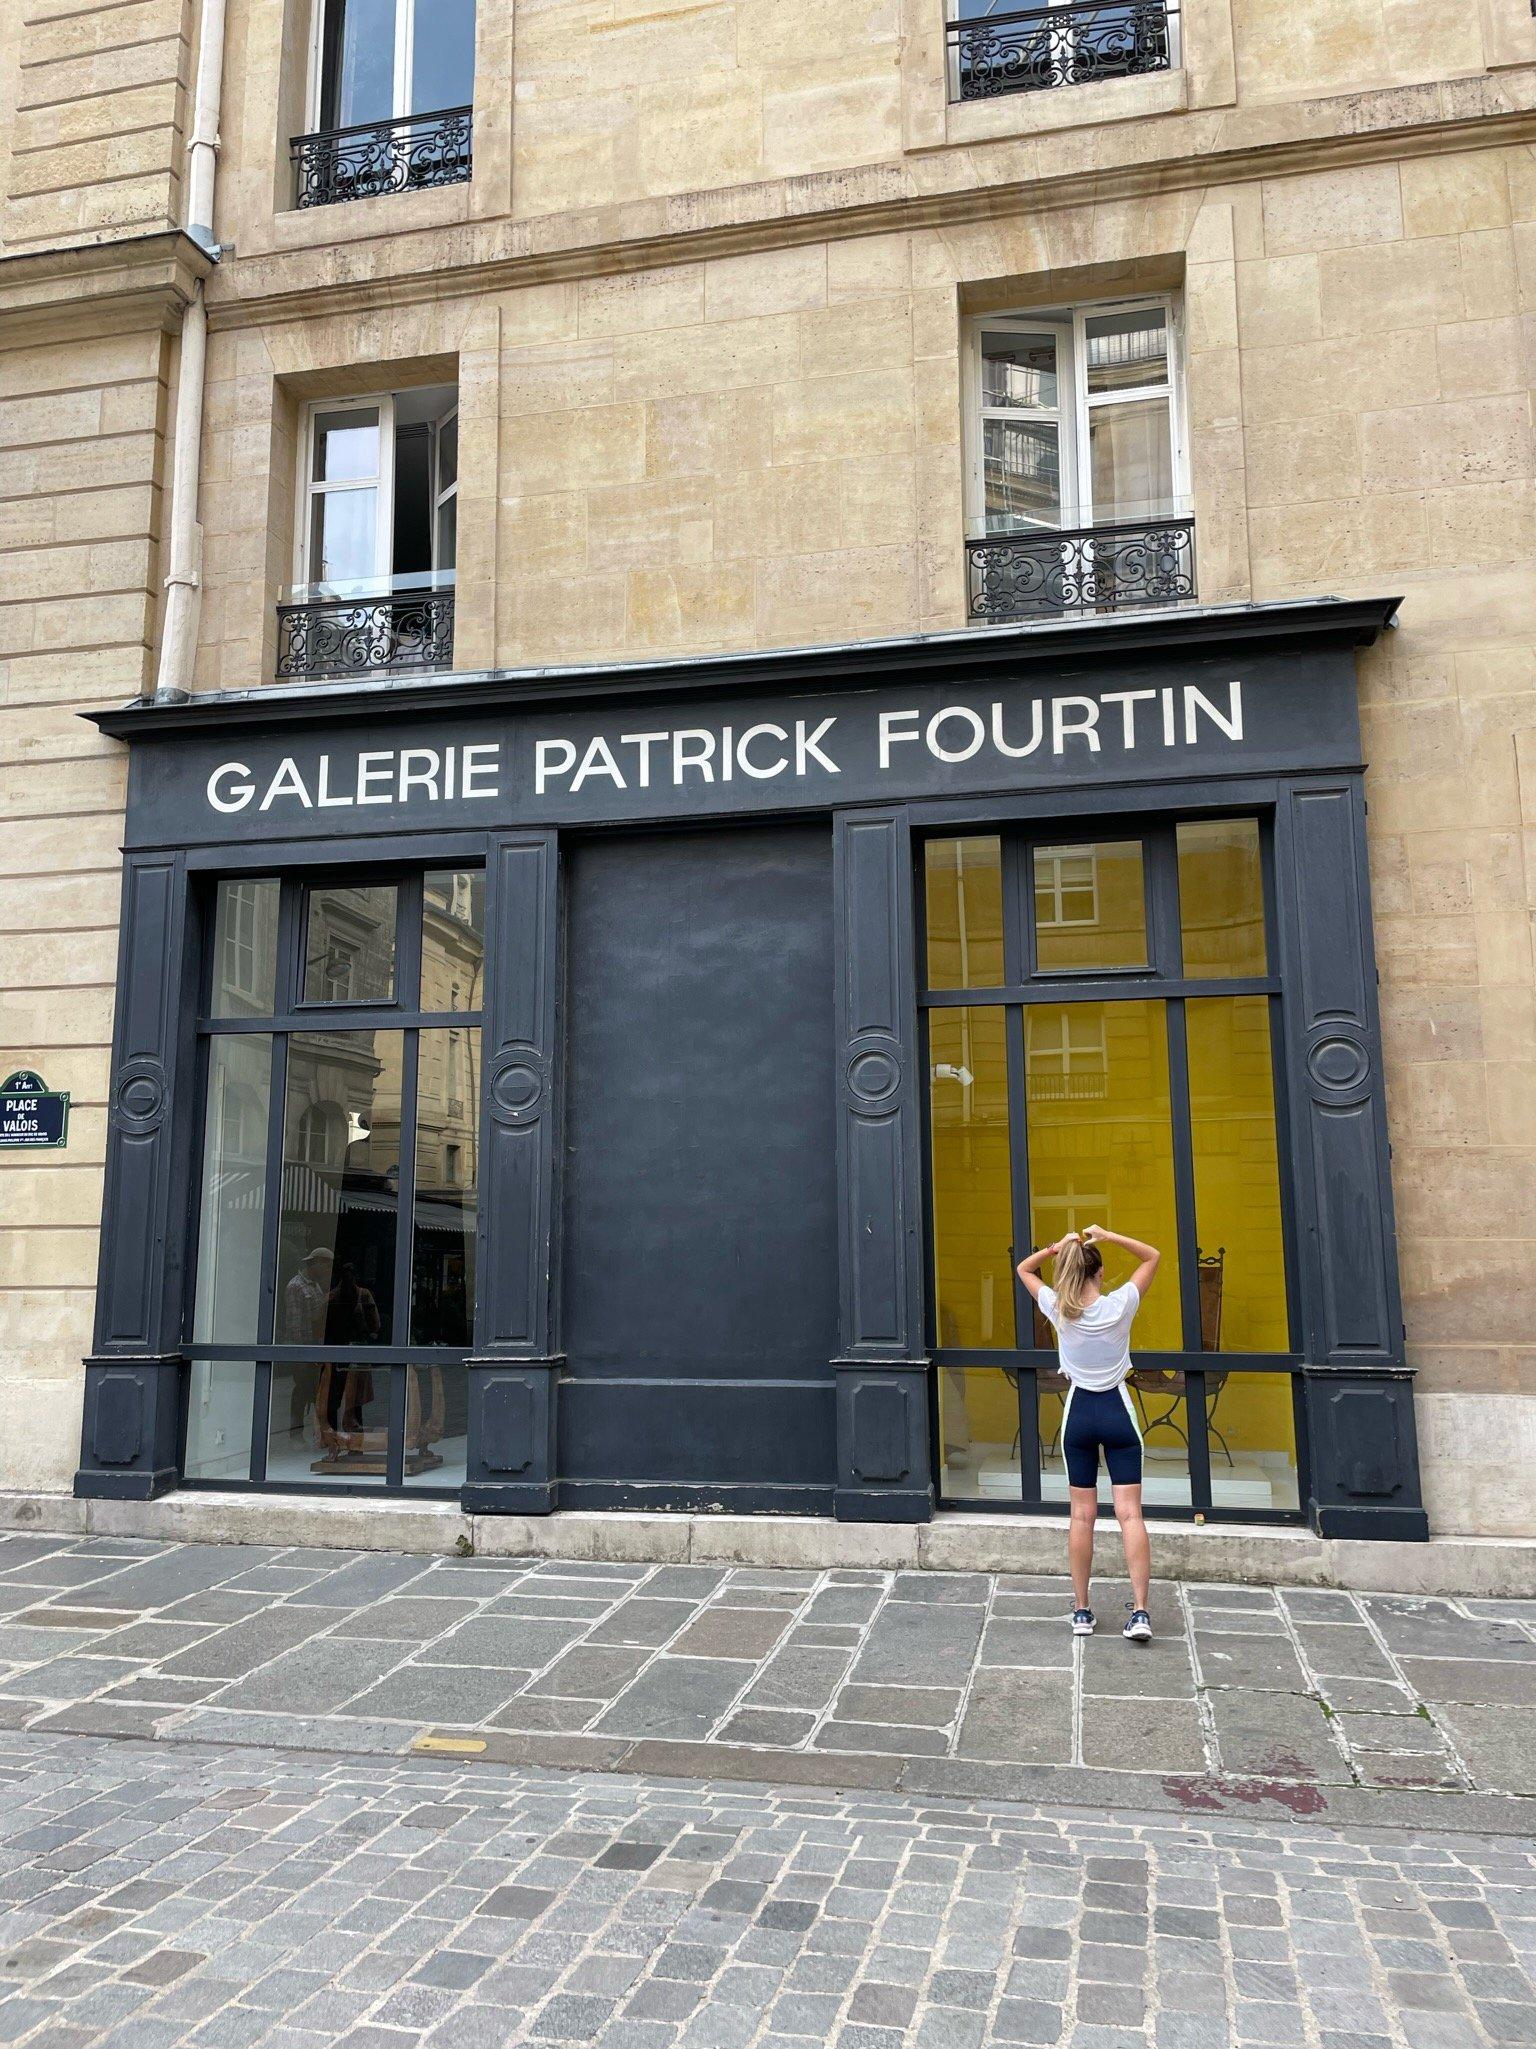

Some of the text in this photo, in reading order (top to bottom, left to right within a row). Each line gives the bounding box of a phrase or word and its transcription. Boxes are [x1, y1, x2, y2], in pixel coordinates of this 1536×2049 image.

[207, 682, 1243, 813] GALERIE PATRICK FOURTIN
[6, 1099, 38, 1111] PLACE
[3, 1120, 38, 1131] VALOIS
